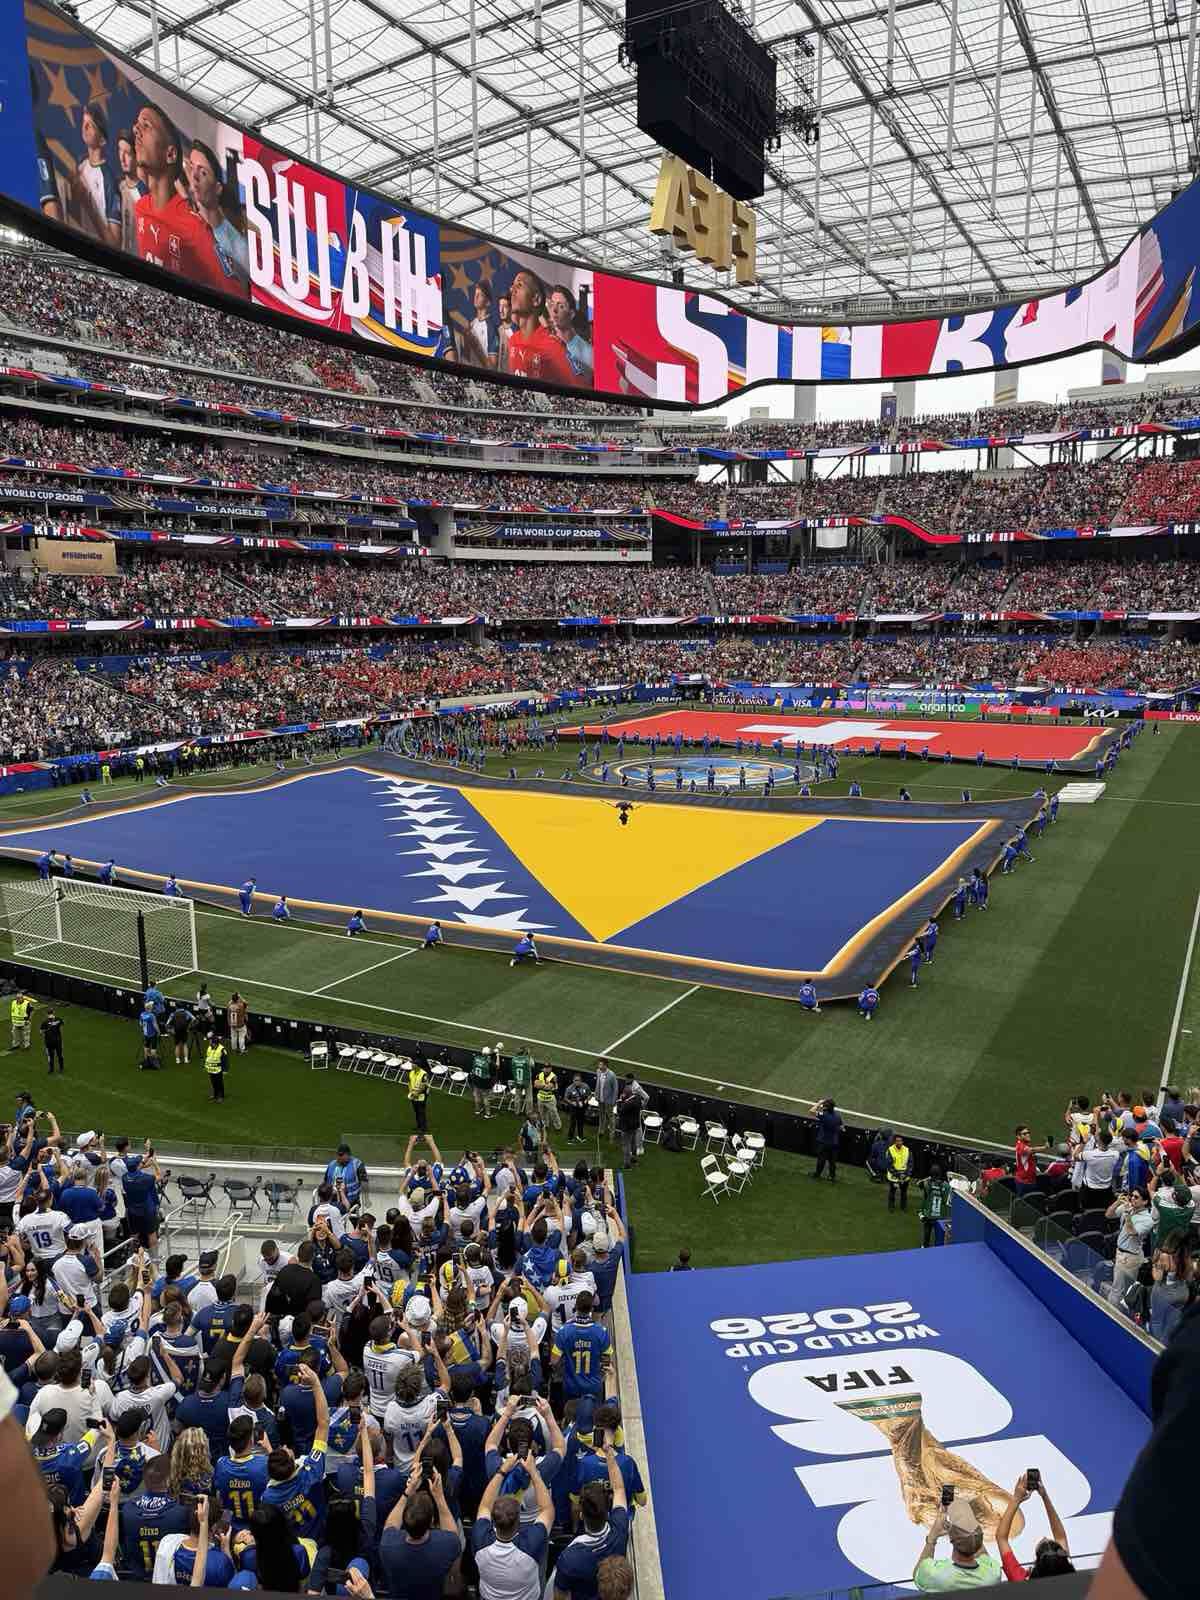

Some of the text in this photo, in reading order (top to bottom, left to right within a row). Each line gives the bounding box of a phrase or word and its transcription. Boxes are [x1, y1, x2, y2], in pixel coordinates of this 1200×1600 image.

[236, 158, 333, 311] SUI
[4, 489, 36, 499] WORLD
[37, 491, 54, 500] CUP
[55, 493, 84, 502] 2026
[195, 505, 267, 517] LOS ANGELES
[504, 528, 601, 538] FIFA WORLD CUP 2026
[712, 696, 736, 705] QATAR
[792, 699, 812, 708] VISA
[919, 703, 966, 713] aramco
[32, 1231, 53, 1249] 19
[709, 1301, 921, 1340] 2026
[725, 1324, 941, 1358] WORLD CUP
[572, 1350, 591, 1376] 11
[371, 1370, 384, 1391] 11
[803, 1366, 915, 1392] FIFA
[229, 1479, 251, 1489] DŽEKO
[229, 1491, 254, 1519] 11
